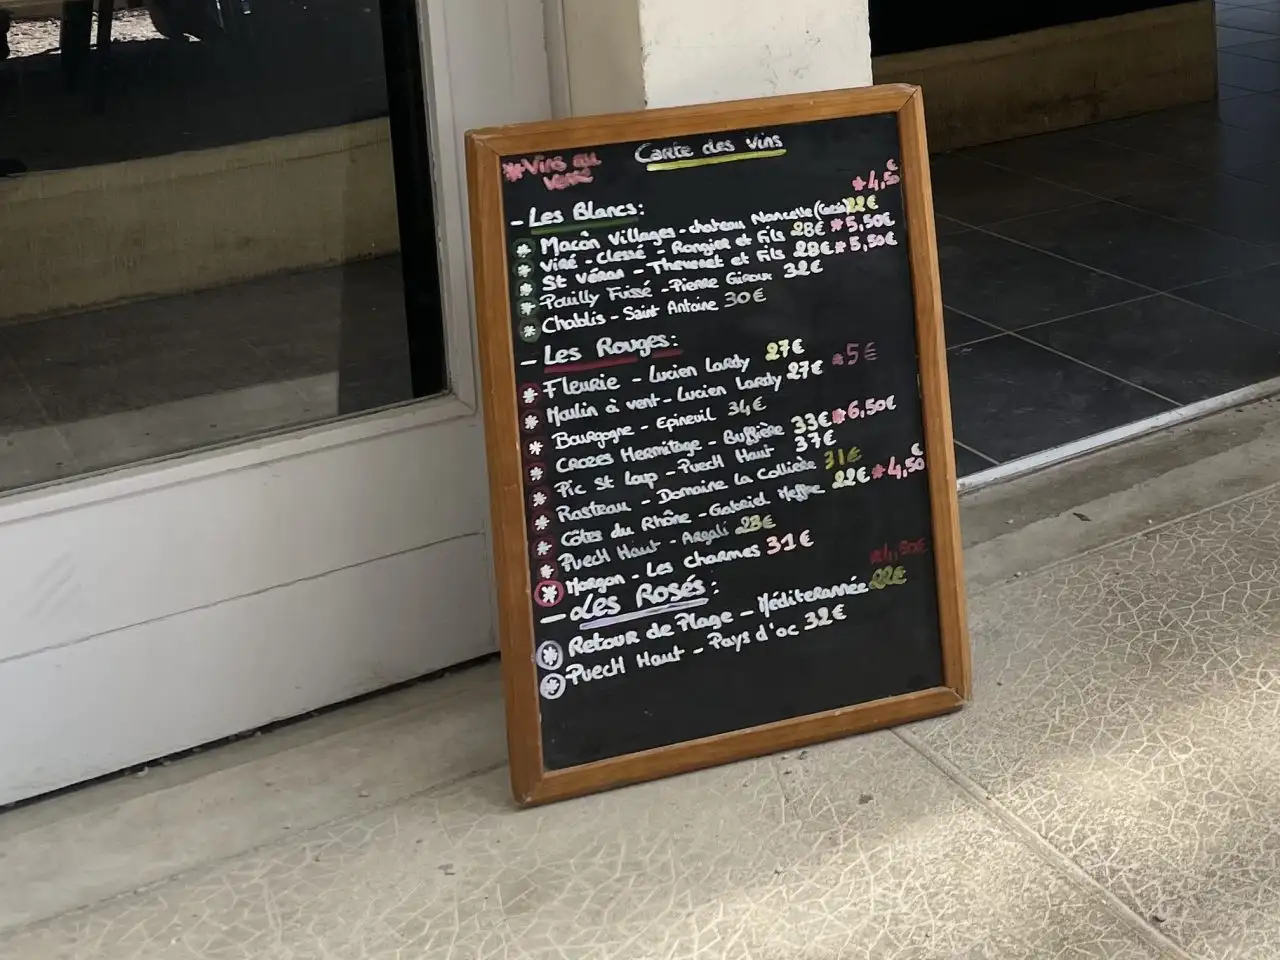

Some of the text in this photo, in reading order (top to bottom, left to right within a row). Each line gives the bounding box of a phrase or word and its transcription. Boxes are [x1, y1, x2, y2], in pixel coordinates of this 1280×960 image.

[634, 142, 694, 163] Carte
[702, 139, 736, 155] des
[529, 207, 564, 228] Les
[790, 221, 826, 238] 28€
[539, 290, 600, 311] Pouilly
[783, 259, 824, 279] 32€
[541, 274, 567, 292] St
[730, 252, 750, 267] et
[793, 240, 834, 258] 28€
[542, 288, 767, 334] Chablis Saint Antoine 30€
[542, 338, 805, 399] Fleurie Lucien Lardy 27€
[544, 344, 582, 366] Les
[605, 398, 620, 414] à
[626, 393, 661, 410] vent
[677, 385, 727, 403] Lucien
[735, 372, 782, 392] Lardy
[786, 360, 824, 380] 27€
[551, 425, 635, 450] Bourgogne
[727, 396, 767, 417] 34€
[620, 439, 703, 463] Hermitage
[791, 411, 832, 435] 33€
[554, 429, 837, 499] Pic St Loup Haut 37€
[556, 500, 632, 523] Rasteau
[656, 479, 729, 505] Domaine
[610, 523, 635, 539] du
[641, 509, 692, 531] Rhône
[566, 529, 814, 596] Morgon Les 31€
[617, 540, 661, 560] Haut
[568, 631, 640, 657] Retour
[646, 622, 674, 640] de
[674, 611, 733, 631] Plage
[636, 645, 685, 669] Haut
[707, 631, 751, 652] Pays
[804, 603, 847, 630] 32€
